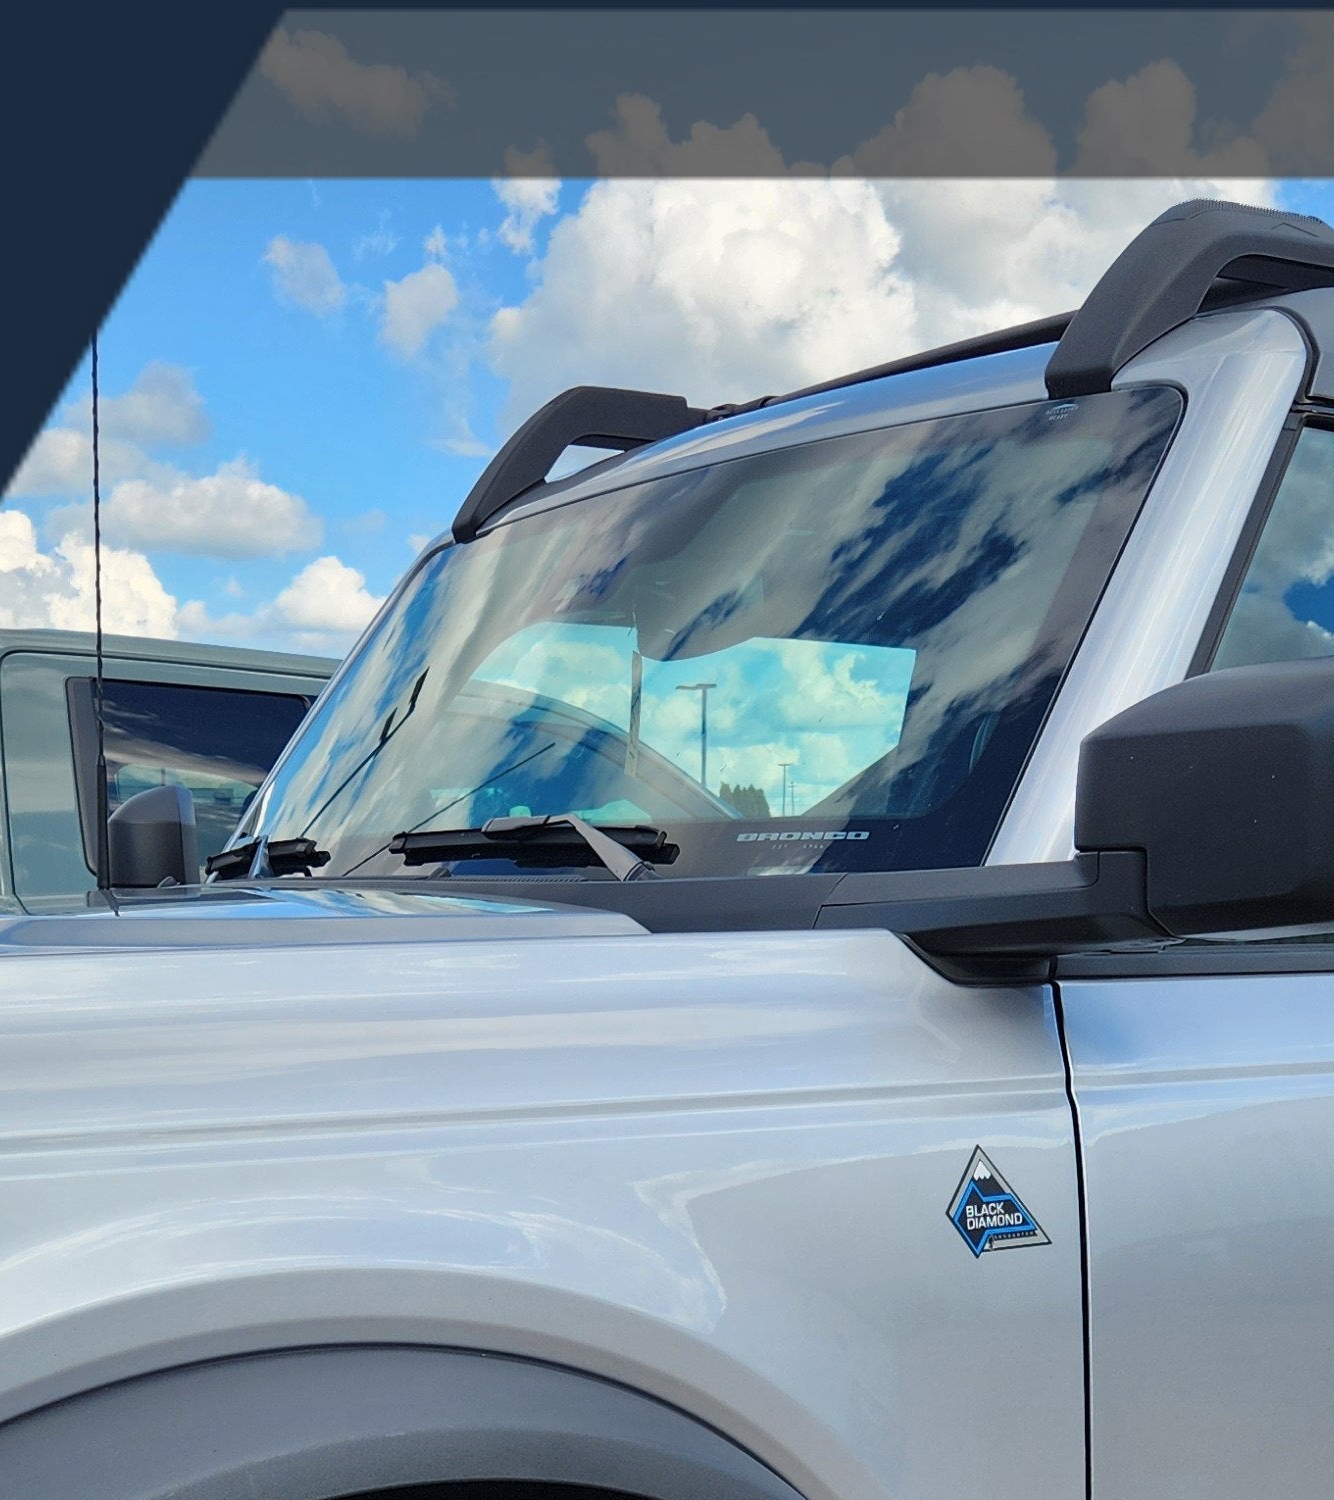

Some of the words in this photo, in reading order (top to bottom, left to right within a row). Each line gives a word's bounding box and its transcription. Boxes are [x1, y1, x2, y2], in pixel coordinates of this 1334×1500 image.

[736, 830, 870, 842] BRONCO
[965, 1202, 1005, 1218] BLACK
[966, 1212, 1023, 1231] DIAMOND
